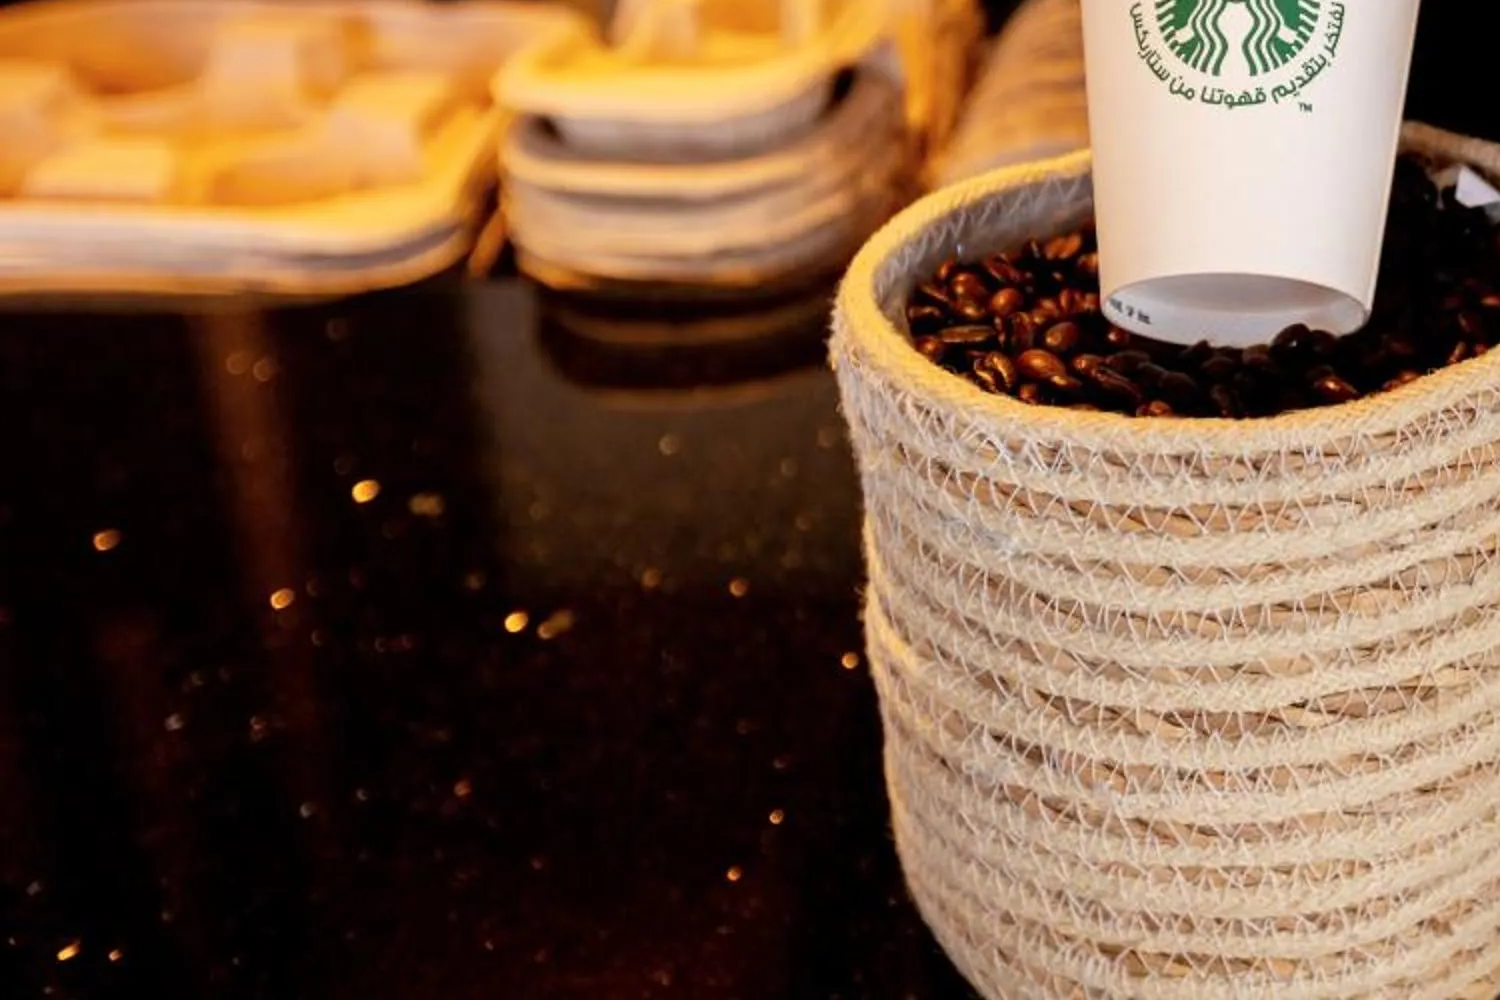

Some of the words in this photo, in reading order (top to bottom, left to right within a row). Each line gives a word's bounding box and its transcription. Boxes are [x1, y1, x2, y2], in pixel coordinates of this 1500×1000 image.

[1129, 2, 1171, 82] ستاربكس
[1324, 1, 1345, 58] نفتخر
[1169, 75, 1196, 101] من
[1200, 85, 1267, 109] قهوتنا
[1271, 53, 1332, 104] بتقديم
